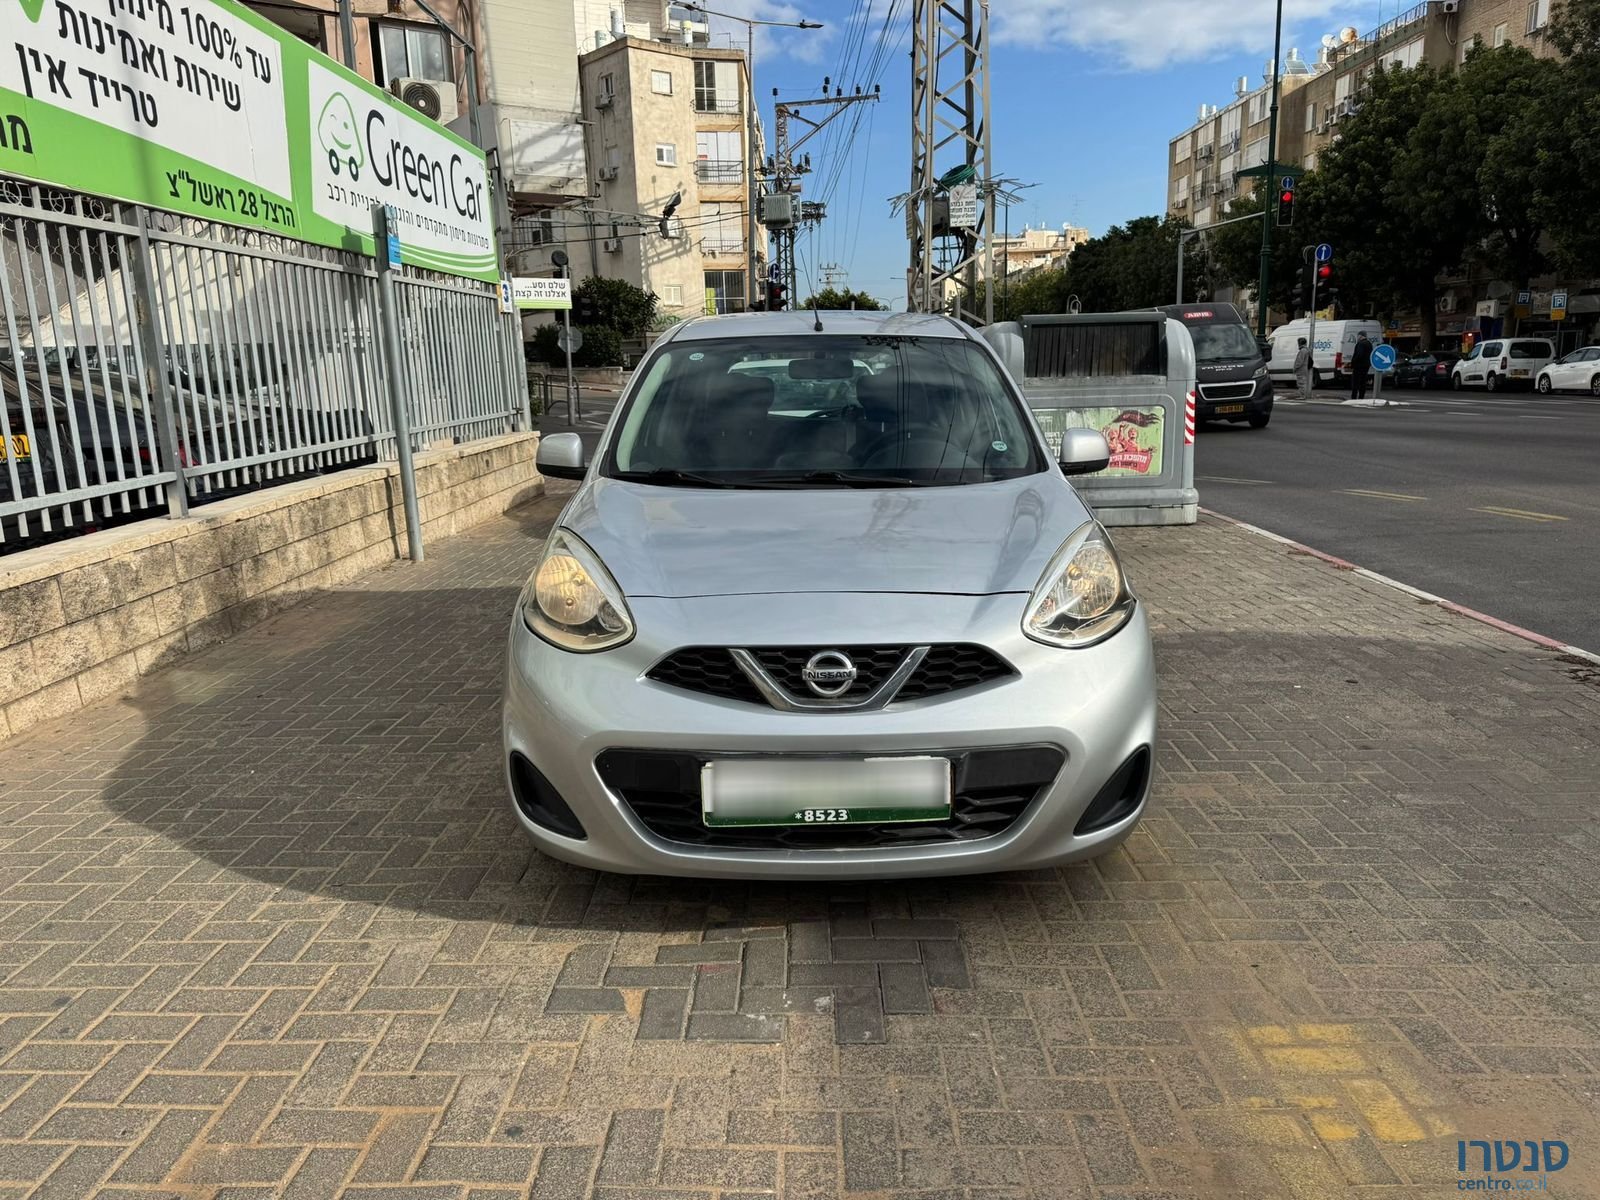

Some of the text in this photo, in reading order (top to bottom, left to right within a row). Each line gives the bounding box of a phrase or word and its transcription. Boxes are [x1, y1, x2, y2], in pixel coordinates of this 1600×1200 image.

[181, 7, 243, 69] 100%
[55, 0, 241, 112] שירות ואמינות
[246, 46, 271, 84] עד
[15, 42, 158, 127] טרייד אין
[367, 109, 482, 223] Green Car
[238, 189, 258, 218] 28
[327, 183, 348, 204] רכב
[260, 194, 296, 228] הרצל
[416, 214, 448, 236] מתקדמים
[449, 224, 466, 244] מימון
[515, 290, 567, 299] אצלנו זה קצת
[549, 281, 566, 290] שלם
[808, 671, 851, 679] NISSAN
